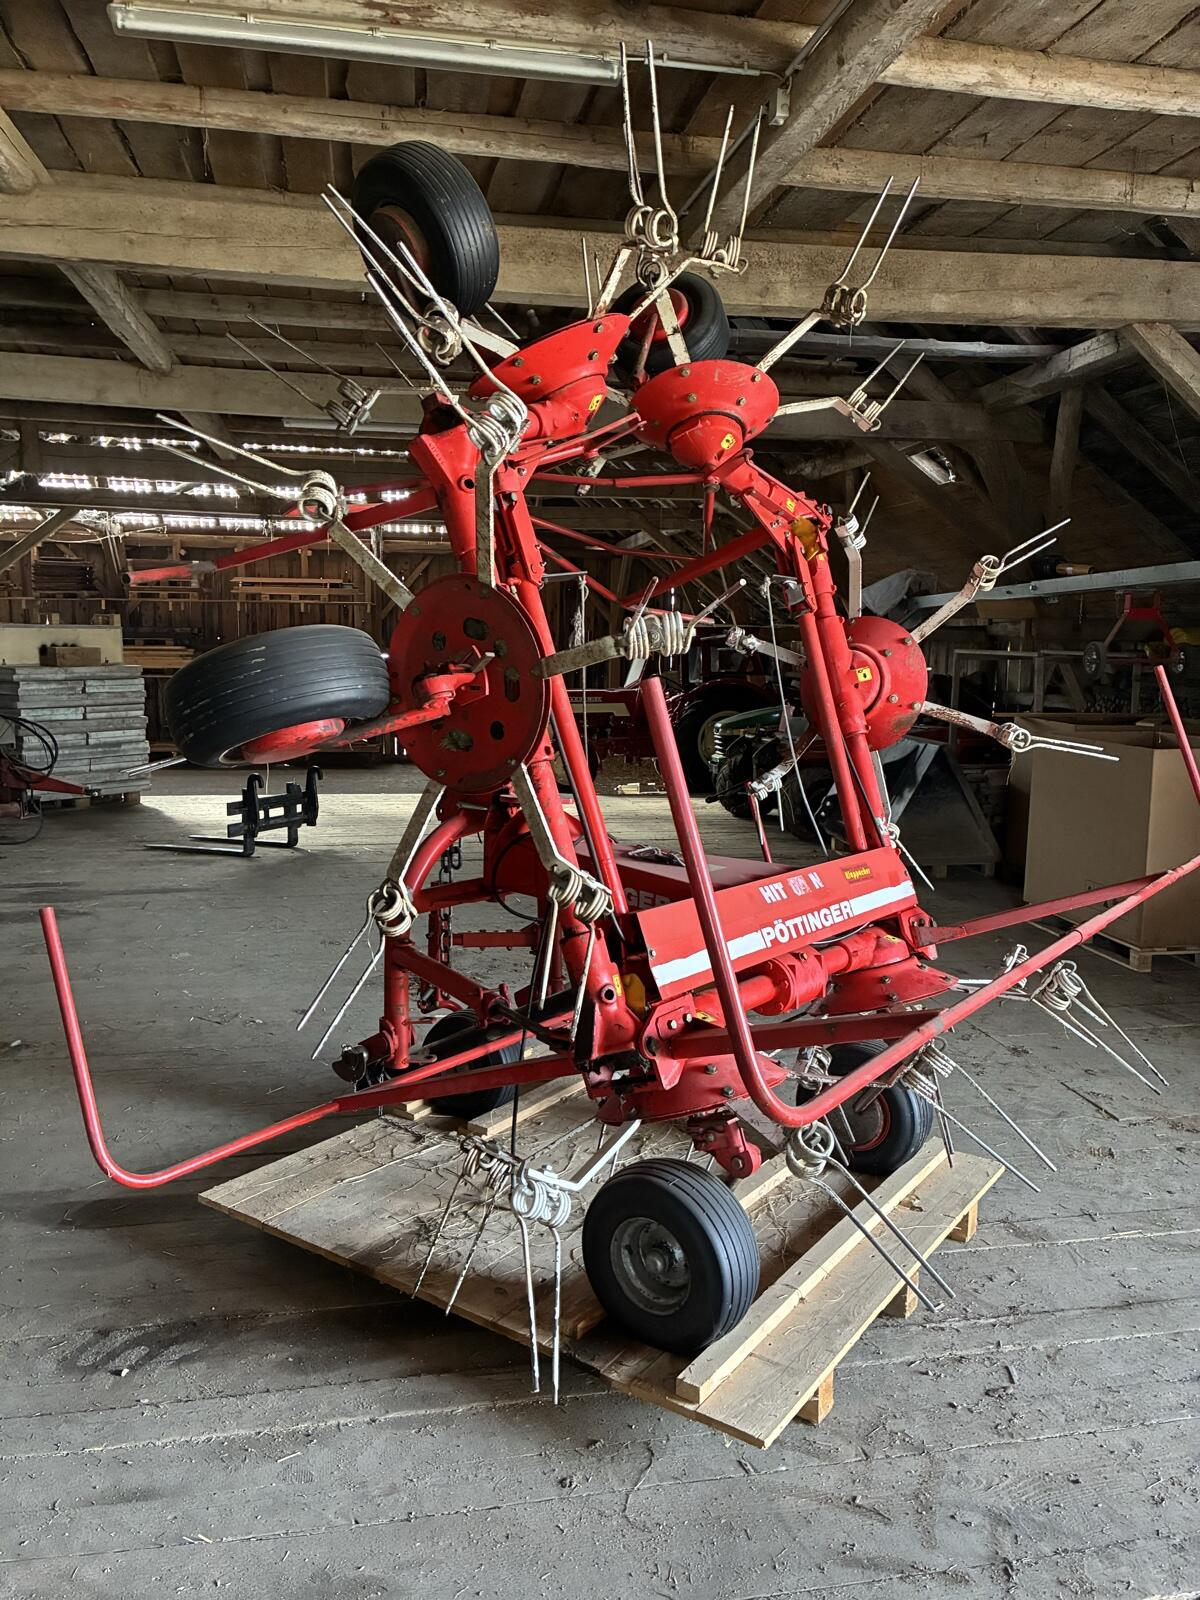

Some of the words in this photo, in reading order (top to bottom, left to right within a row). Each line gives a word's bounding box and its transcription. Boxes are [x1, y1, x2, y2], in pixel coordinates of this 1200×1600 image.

[758, 881, 788, 904] HIT
[807, 871, 825, 890] N
[761, 900, 854, 948] PÖTTINGER
